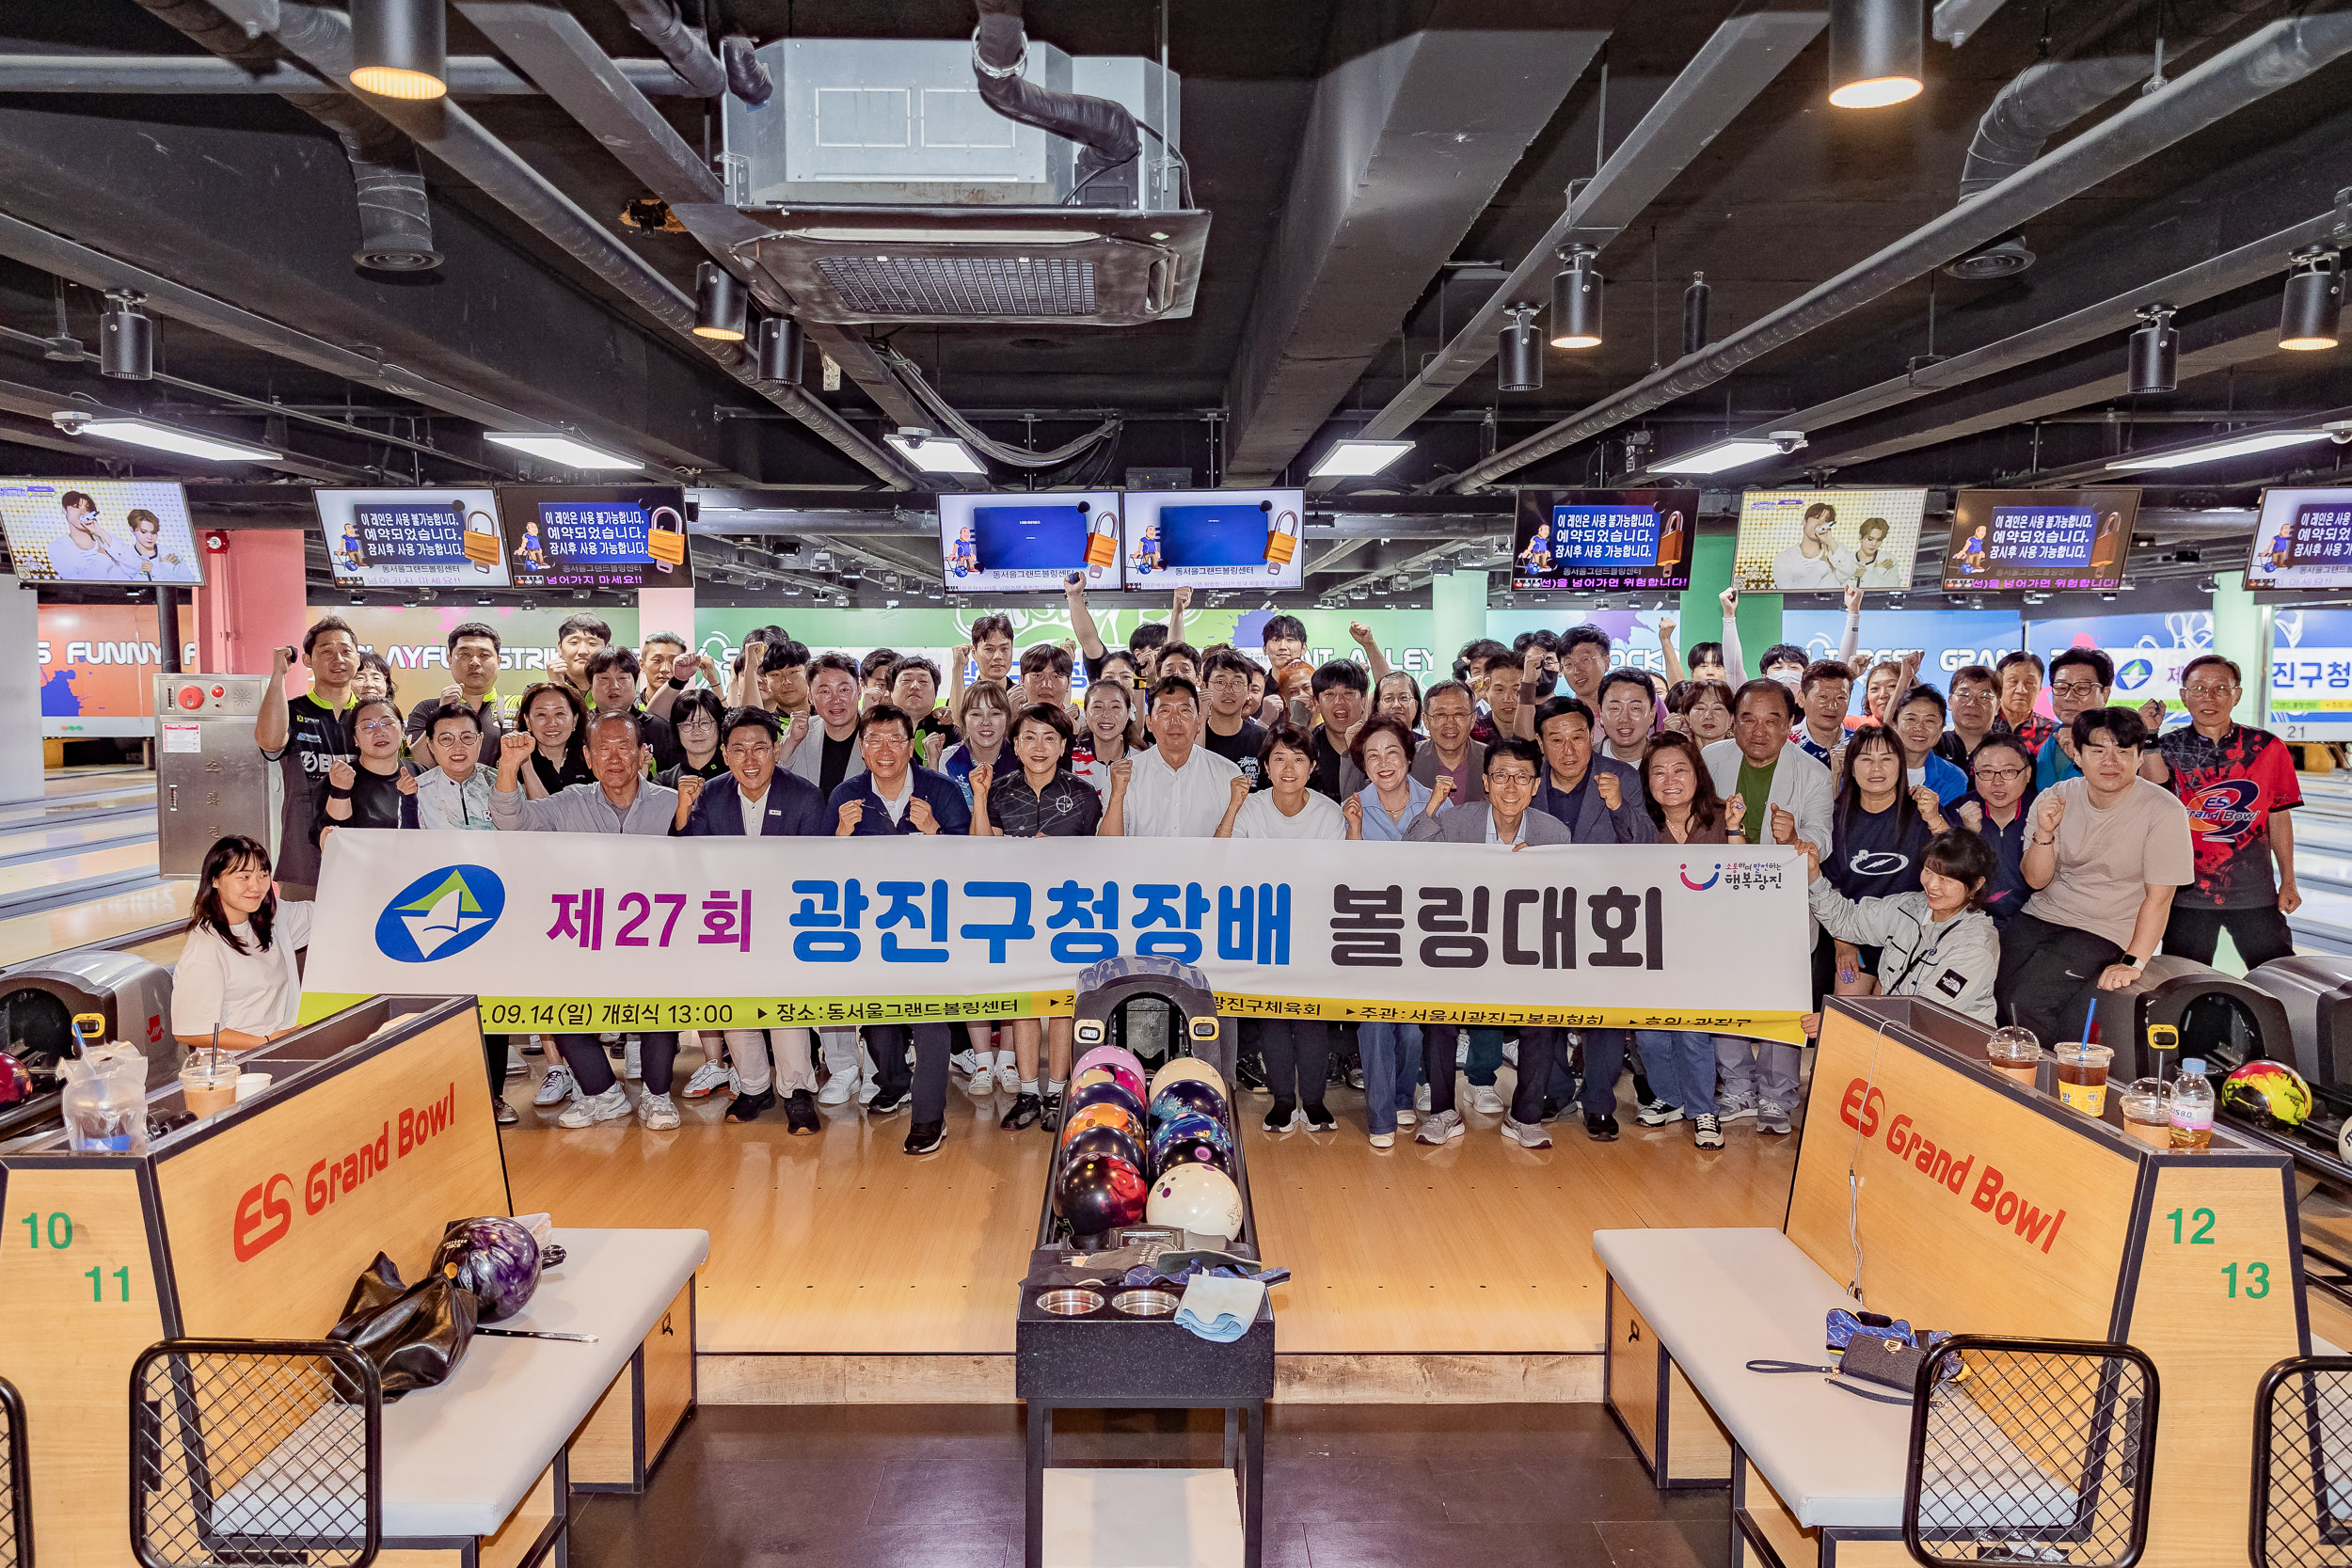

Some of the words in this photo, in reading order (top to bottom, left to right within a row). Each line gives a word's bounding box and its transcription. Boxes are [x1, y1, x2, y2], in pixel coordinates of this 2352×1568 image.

[361, 514, 370, 527] 이
[395, 514, 410, 527] 사용
[411, 513, 459, 527] 불가능합니다.
[545, 512, 554, 525] 이
[555, 511, 579, 525] 레인은
[580, 511, 595, 525] 사용
[596, 511, 644, 525] 불가능합니다.
[1557, 515, 1565, 528] 이
[1567, 514, 1590, 528] 레인은
[1591, 514, 1607, 528] 사용
[1608, 514, 1655, 528] 불가능합니다.
[1994, 515, 2002, 529] 이
[2005, 515, 2028, 529] 레인은
[2028, 515, 2045, 529] 사용
[2045, 515, 2093, 529] 불가능합니다.
[2300, 513, 2310, 526] 이
[2310, 512, 2334, 526] 레인은
[2334, 512, 2351, 526] 사용
[364, 528, 462, 541] 예약되었습니다.
[548, 526, 646, 540] 예약되었습니다.
[1556, 529, 1654, 543] 예약되었습니다.
[1993, 530, 2090, 544] 예약되었습니다.
[367, 543, 395, 557] 잠시후
[398, 543, 415, 557] 사용
[418, 543, 465, 557] 가능합니다.
[549, 542, 577, 556] 잠시후
[580, 542, 597, 556] 사용
[599, 541, 648, 556] 가능합니다.
[1555, 545, 1582, 558] 잠시후
[1584, 545, 1602, 558] 사용
[1604, 545, 1652, 558] 가능합니다.
[1989, 546, 2017, 559] 잠시후
[2018, 546, 2037, 559] 사용
[2039, 546, 2087, 559] 가능합니다.
[2294, 543, 2322, 557] 잠시후
[2323, 543, 2343, 557] 사용
[1175, 566, 1254, 577] 동서울그랜드볼링센터
[546, 575, 595, 585] 넘어가지
[598, 575, 643, 585] 마세요!!
[1572, 578, 1619, 588] 넘어가면
[1623, 578, 1687, 588] 위험합니다!
[2004, 578, 2051, 589] 넘어가면
[2055, 578, 2119, 588] 위험합니다!
[66, 641, 162, 665] FUNNY
[1349, 647, 1434, 672] ALEY
[2287, 725, 2305, 739] 21
[2203, 797, 2231, 810] ES
[2222, 810, 2261, 822] Bowl
[1725, 862, 1752, 873] 소통하며
[1753, 862, 1782, 874] 발전하는
[1724, 872, 1782, 891] 행복광진
[788, 878, 1293, 967] 광진구청장배
[1329, 883, 1664, 971] 볼링대회
[1214, 995, 1321, 1017] 광진구체육회
[479, 1003, 593, 1027] .09.14(일)
[601, 1004, 660, 1026] 개회식
[668, 1004, 733, 1024] 13:00
[234, 1172, 295, 1263] ES
[305, 1120, 389, 1216] Grand
[398, 1082, 454, 1160] Bowl
[1840, 1077, 1885, 1138] ES
[1886, 1114, 1976, 1196] Grand
[1970, 1164, 2067, 1255] Bowl
[22, 1212, 73, 1250] 10
[2167, 1208, 2216, 1244] 12
[85, 1266, 130, 1303] 11
[2221, 1261, 2270, 1299] 13
